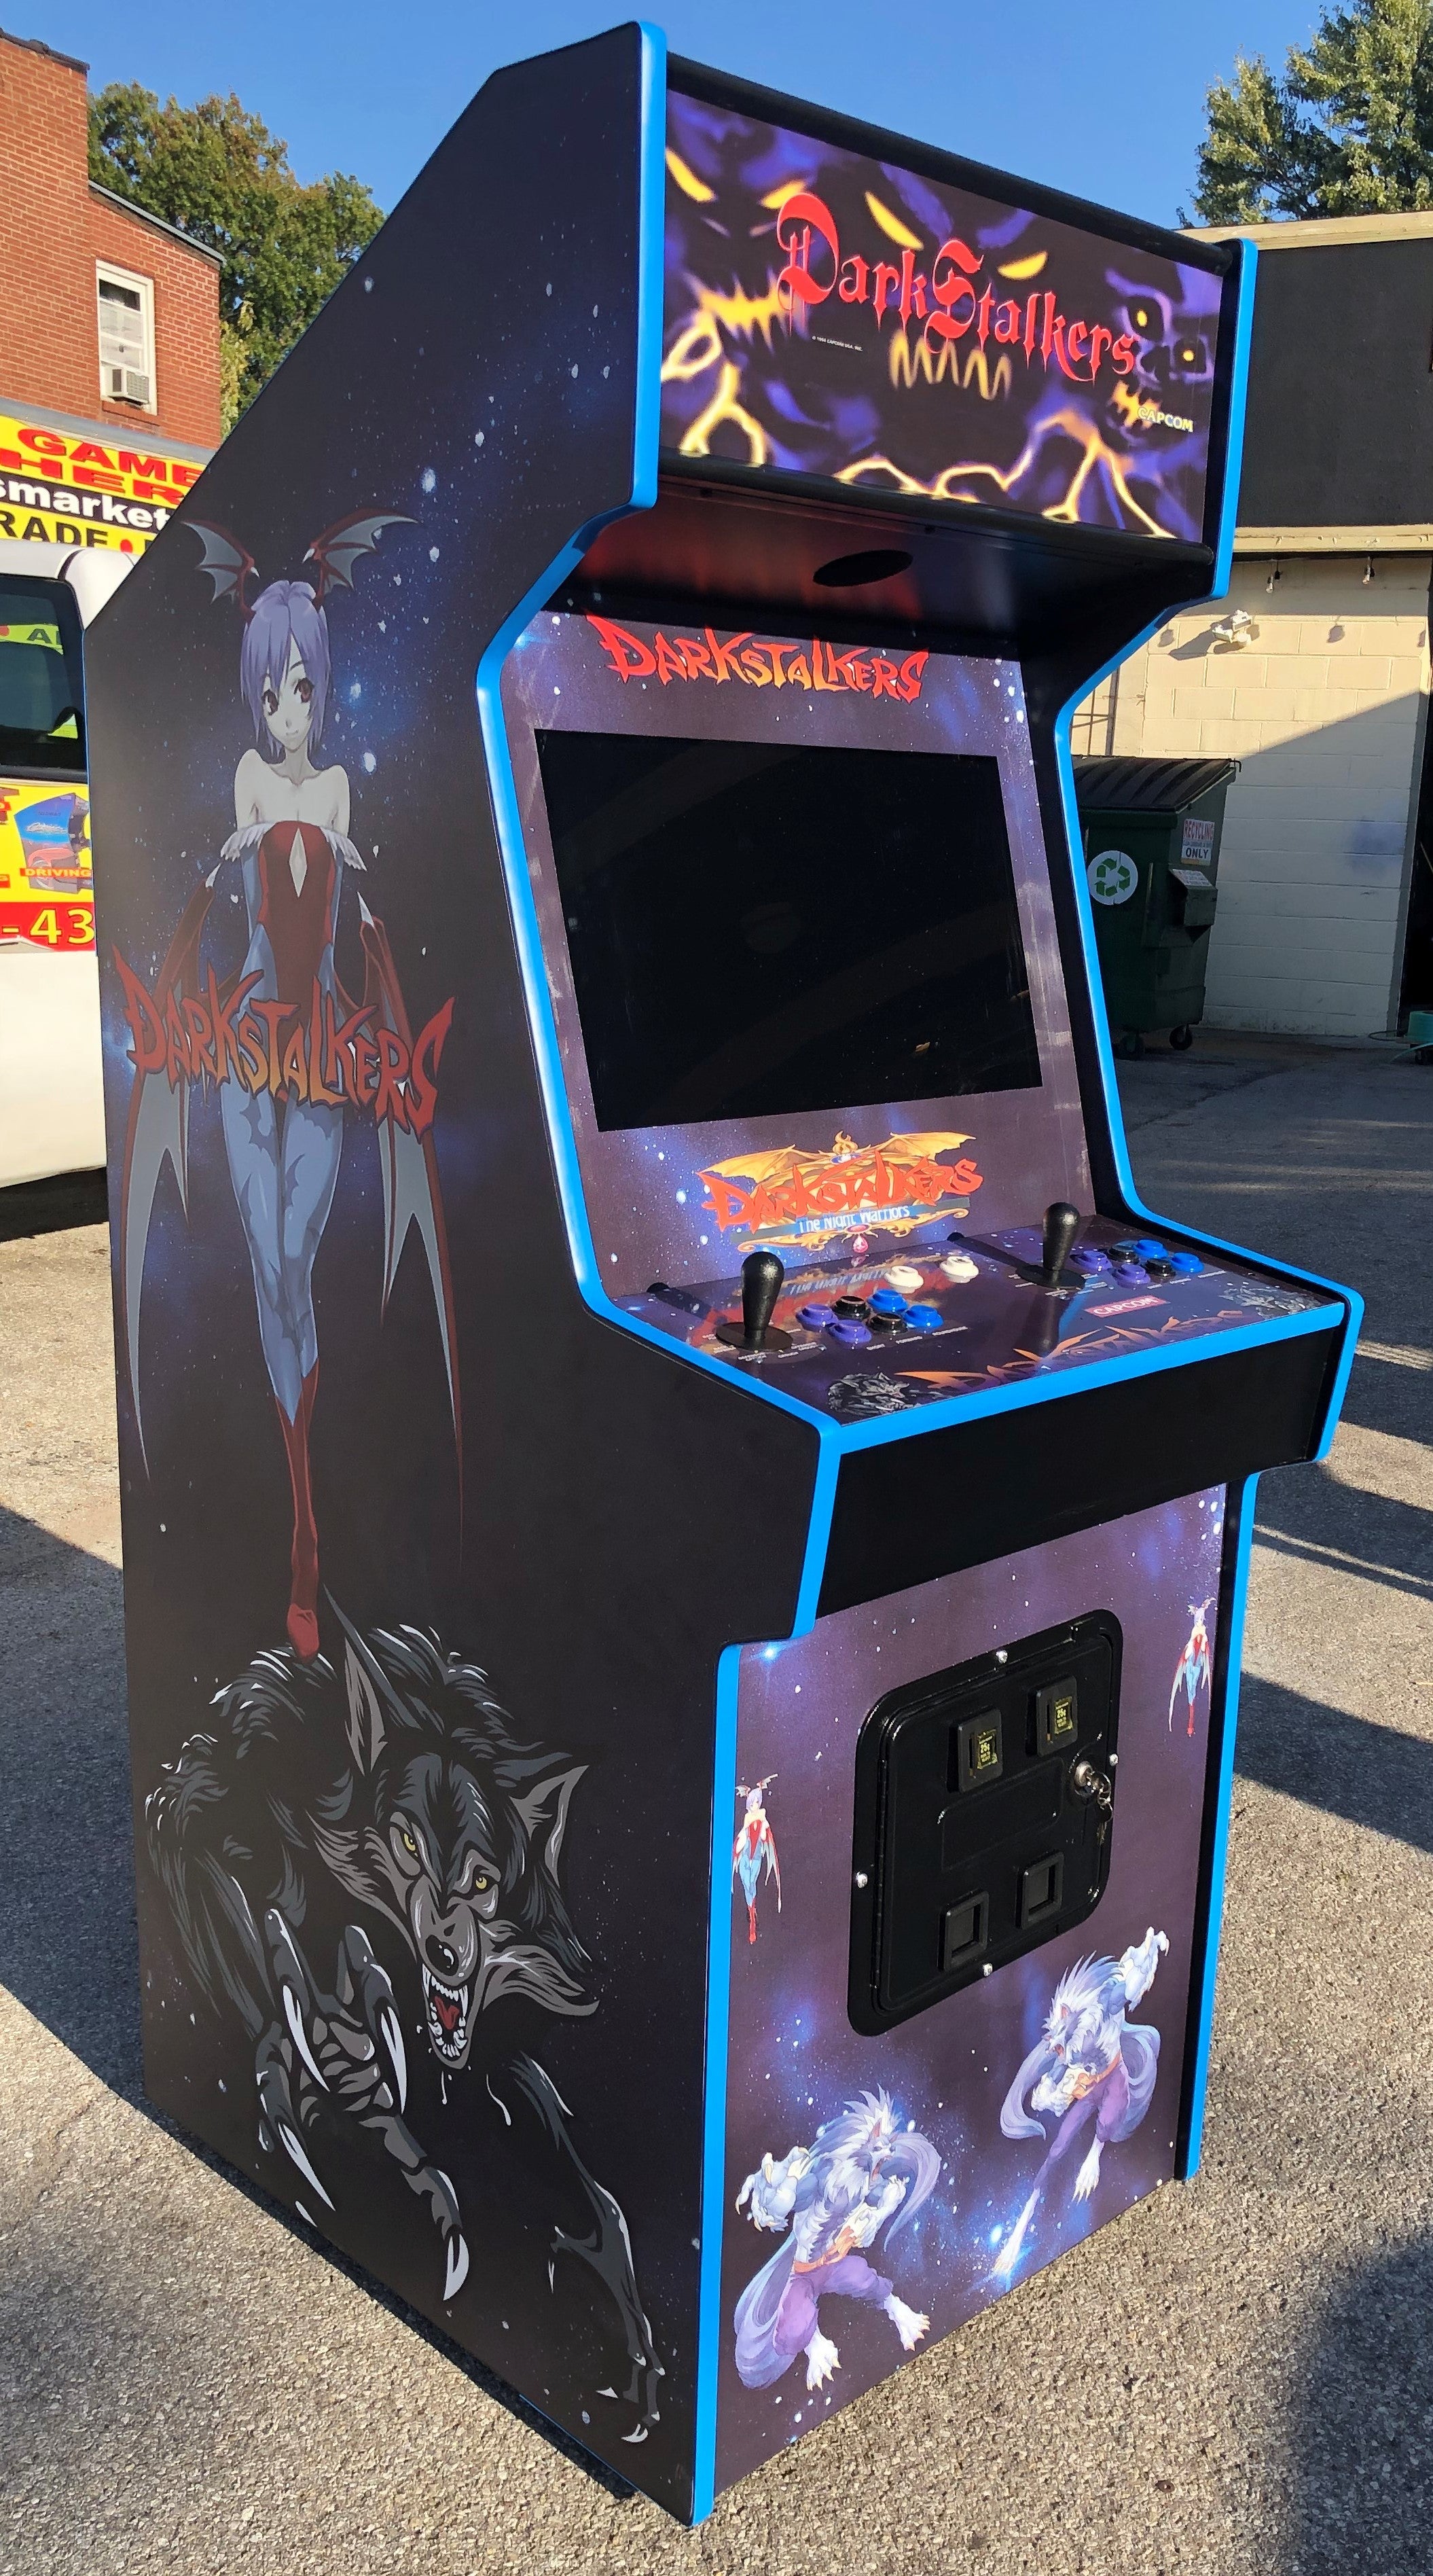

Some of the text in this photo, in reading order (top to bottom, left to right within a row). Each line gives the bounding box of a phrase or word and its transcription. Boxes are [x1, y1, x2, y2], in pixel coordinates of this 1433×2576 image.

[1138, 407, 1194, 433] CAPCOM
[18, 429, 202, 488] GAME
[0, 478, 171, 531] market
[585, 609, 930, 704] DARKSTALKERS
[1184, 820, 1214, 841] RECYCLING
[1185, 847, 1209, 859] ONLY
[24, 867, 92, 878] DRIVING
[113, 945, 457, 1145] DARKSTALKERS
[1093, 1297, 1158, 1315] CAPCOM
